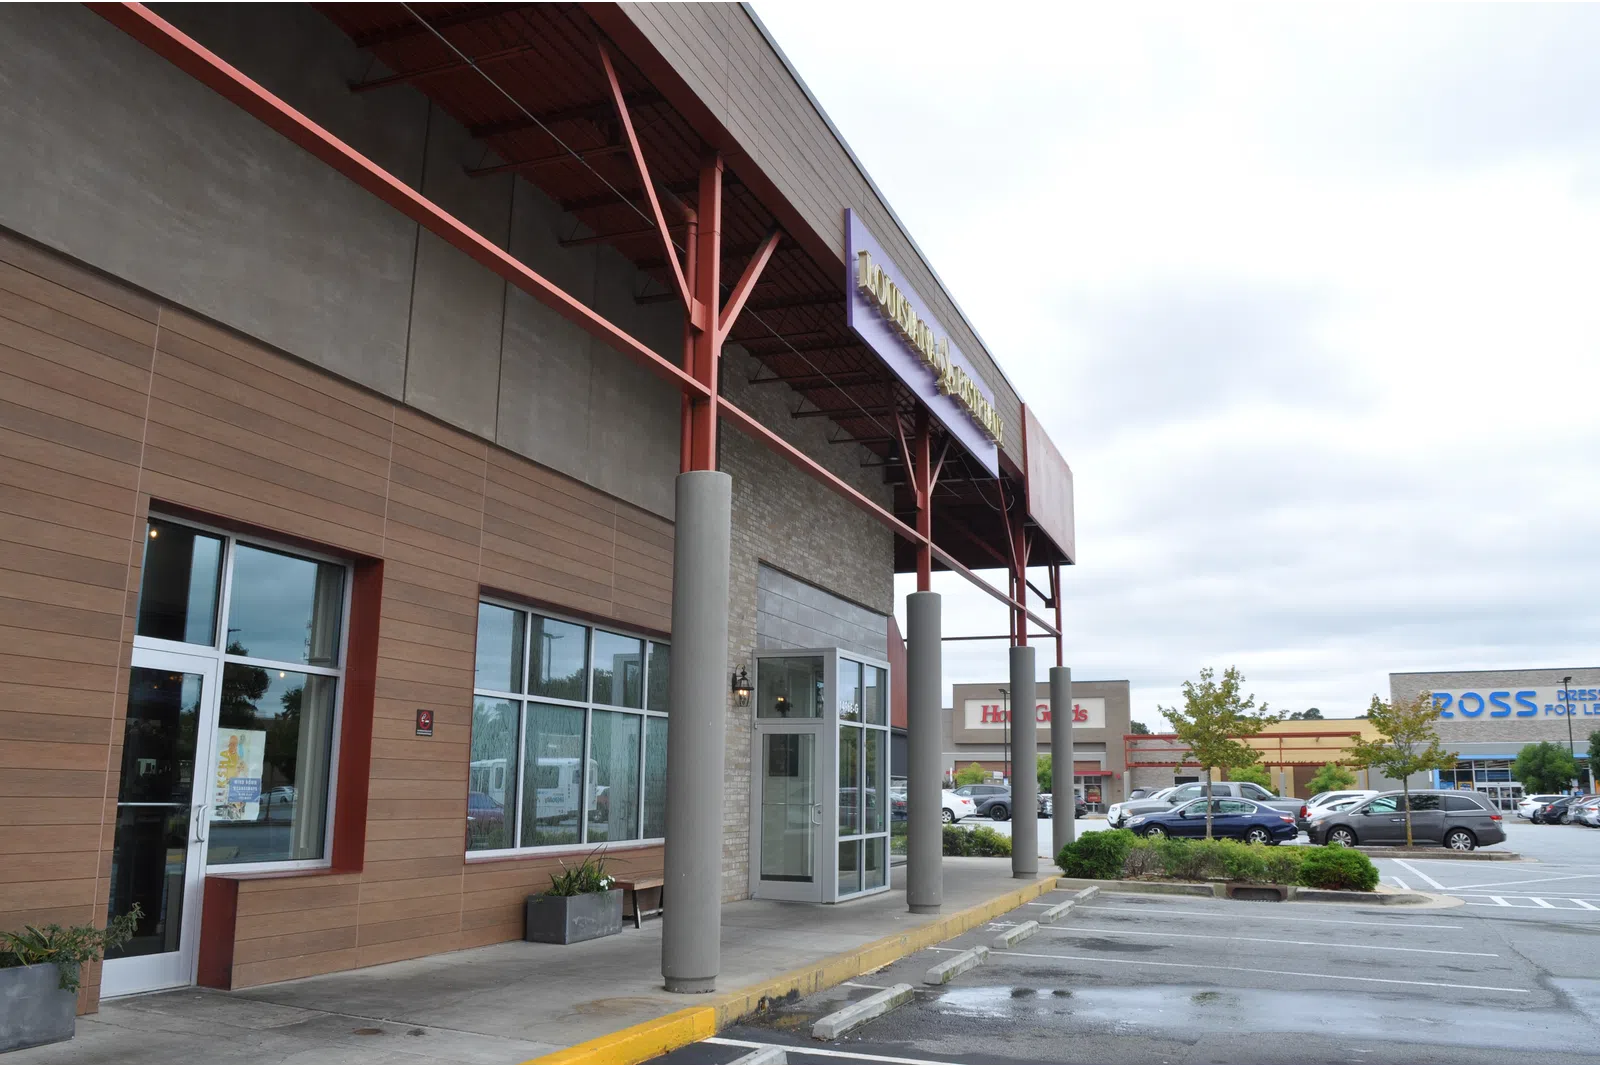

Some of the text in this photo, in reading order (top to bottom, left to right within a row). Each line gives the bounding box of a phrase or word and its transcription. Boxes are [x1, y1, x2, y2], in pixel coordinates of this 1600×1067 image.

[857, 249, 939, 370] LOUISIANA
[1432, 690, 1538, 718] ROSS
[1557, 689, 1600, 701] DRES
[980, 704, 1088, 723] HoGds
[1544, 703, 1577, 716] FOR
